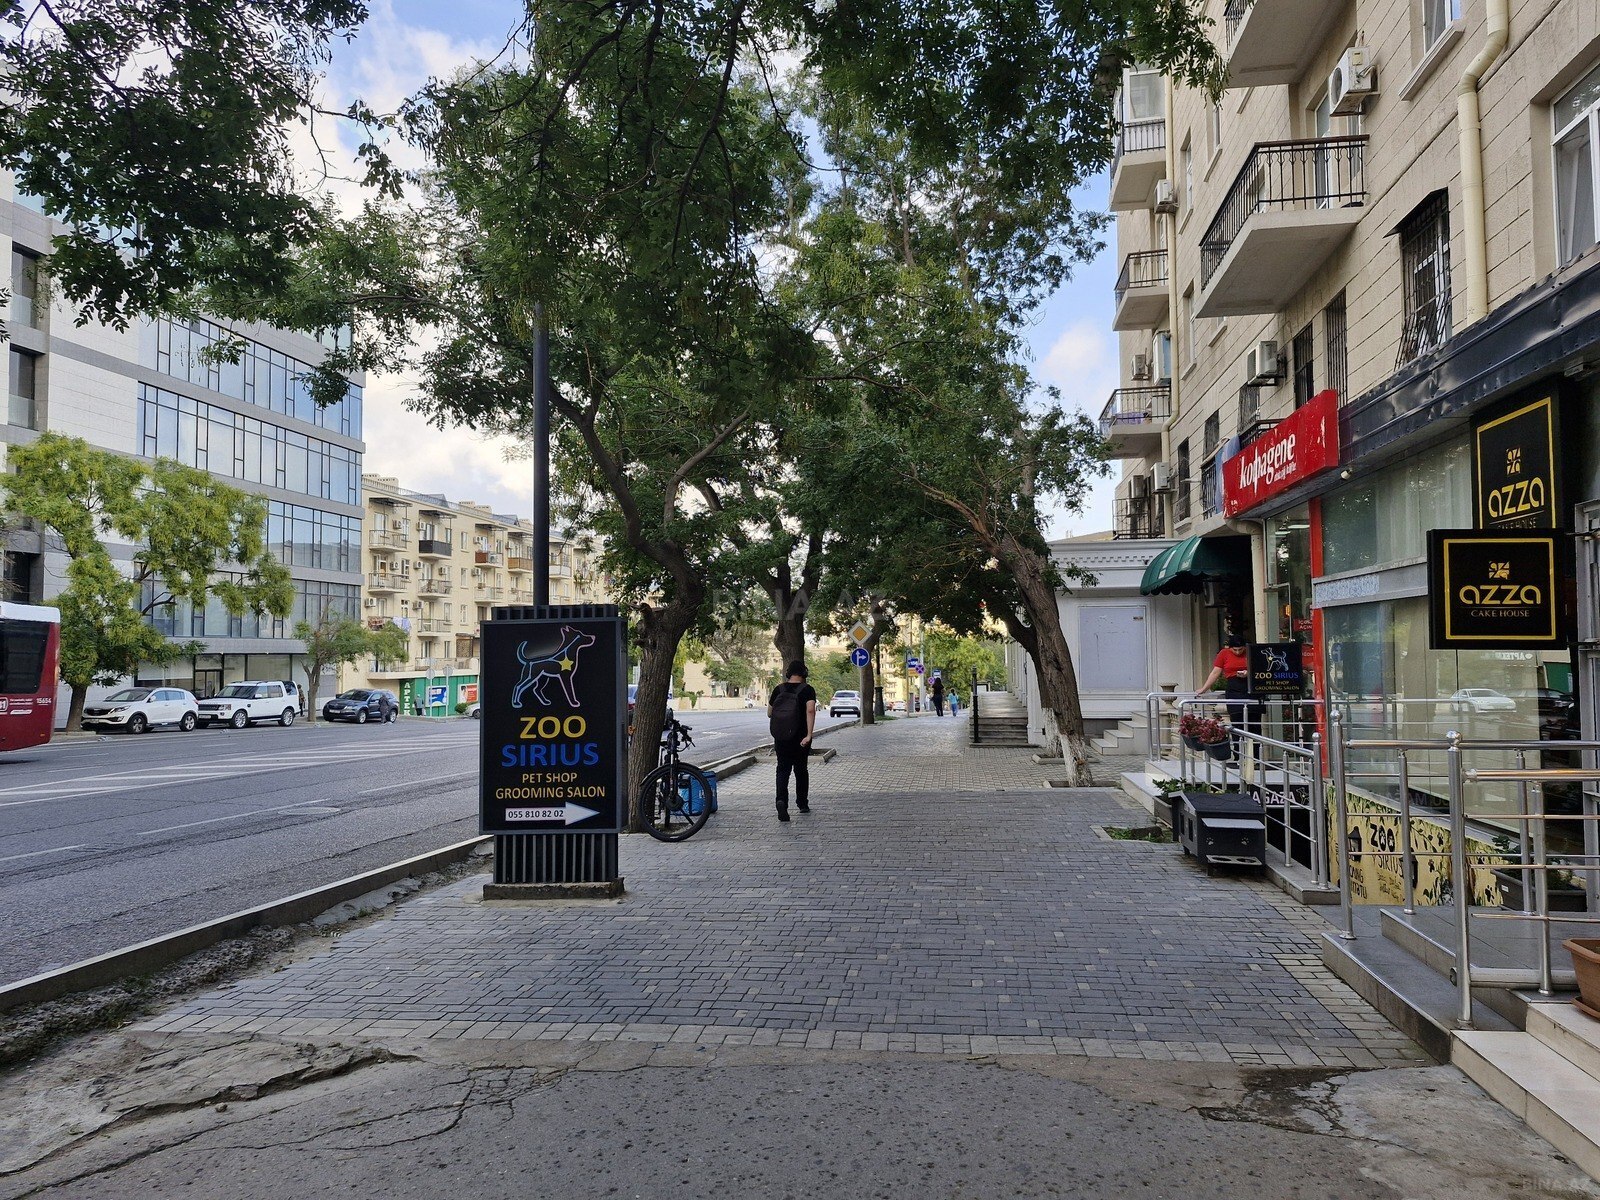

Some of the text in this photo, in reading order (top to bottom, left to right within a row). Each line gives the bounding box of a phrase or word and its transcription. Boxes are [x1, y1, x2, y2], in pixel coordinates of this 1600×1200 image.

[1488, 477, 1545, 518] azza
[1459, 585, 1542, 605] azza
[1471, 609, 1530, 618] CAKE HOUSE
[519, 715, 587, 739] ZOO
[501, 743, 599, 767] SIRIUS
[522, 772, 578, 783] PET SHOP
[495, 786, 606, 799] GROOMING SALON
[508, 810, 523, 819] 055
[524, 810, 540, 818] 810
[1370, 822, 1395, 853] ZOO
